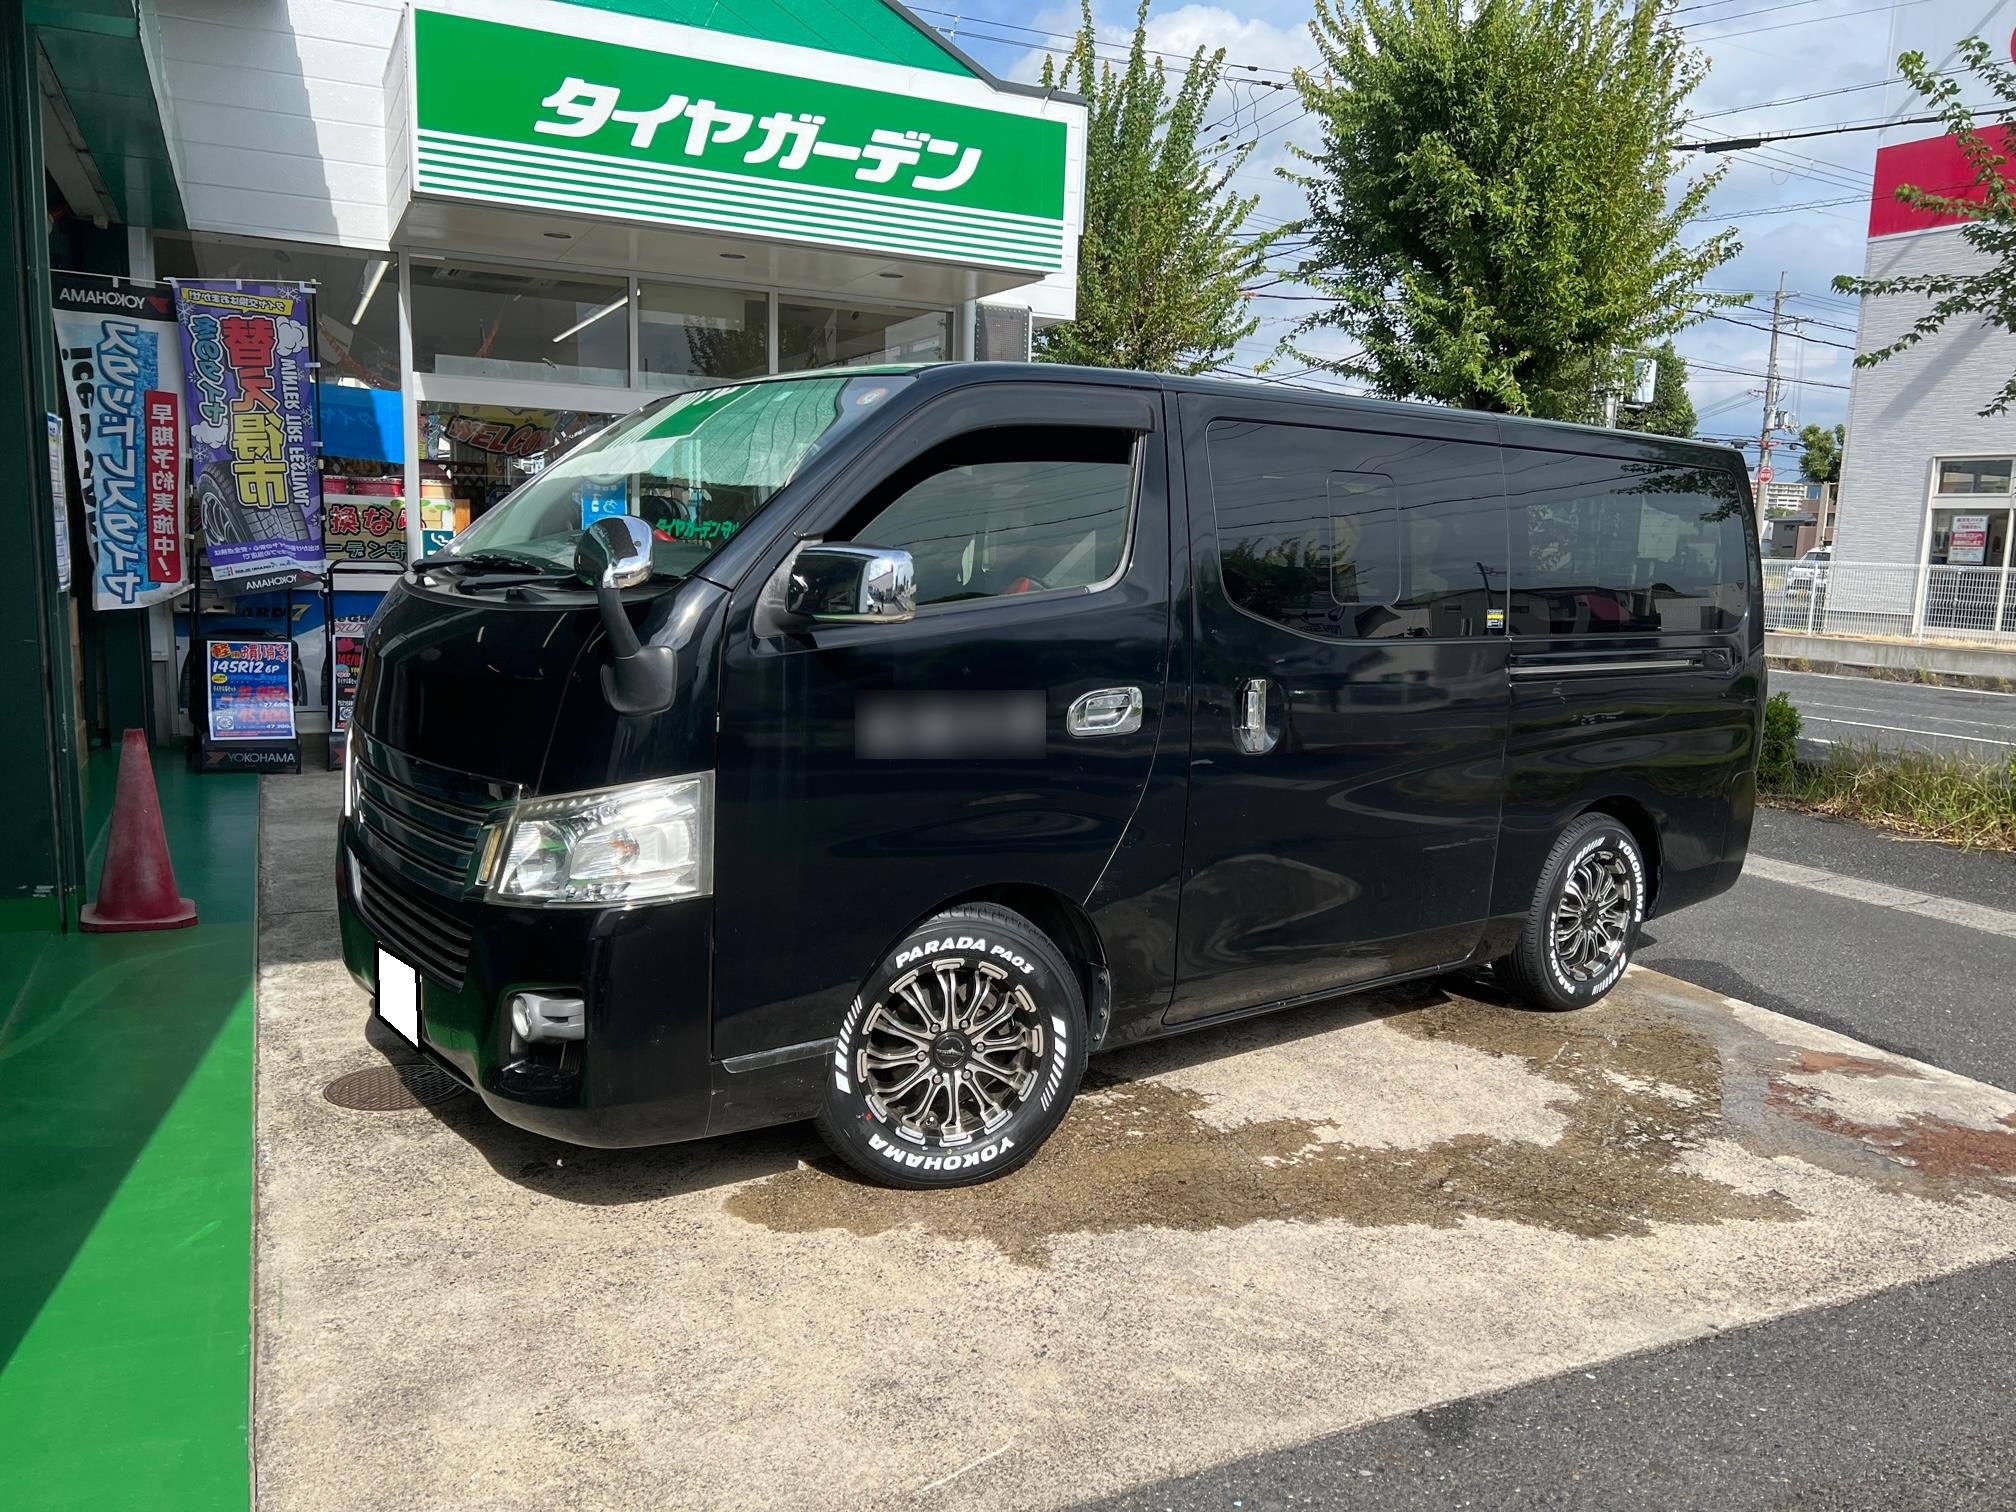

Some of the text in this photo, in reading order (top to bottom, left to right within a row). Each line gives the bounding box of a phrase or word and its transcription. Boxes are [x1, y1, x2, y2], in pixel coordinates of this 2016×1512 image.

[534, 77, 982, 192] タイヤガーデン
[212, 661, 264, 673] 145R12
[227, 753, 296, 763] YOKOHAMA
[1617, 839, 1645, 923] YOKOHAMA
[895, 936, 1036, 974] PARADA PA03
[868, 1133, 1015, 1171] YOKOHAMA
